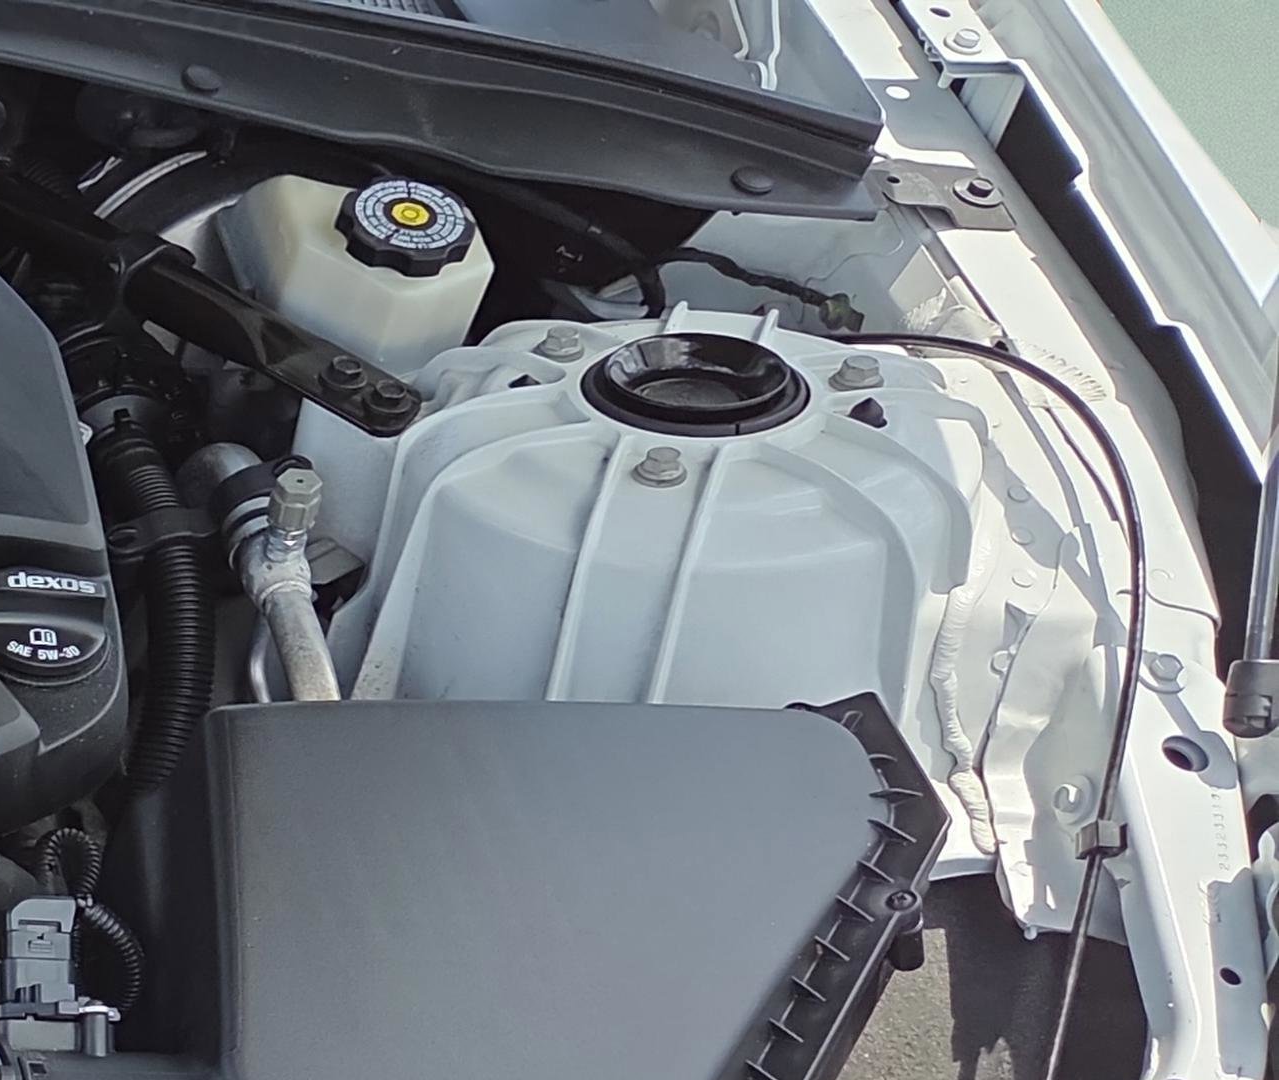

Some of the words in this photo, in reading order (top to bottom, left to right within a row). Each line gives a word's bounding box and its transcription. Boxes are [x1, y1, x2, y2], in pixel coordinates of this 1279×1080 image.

[7, 571, 97, 594] dexos
[6, 640, 33, 658] SAE
[37, 645, 81, 661] 5W-30
